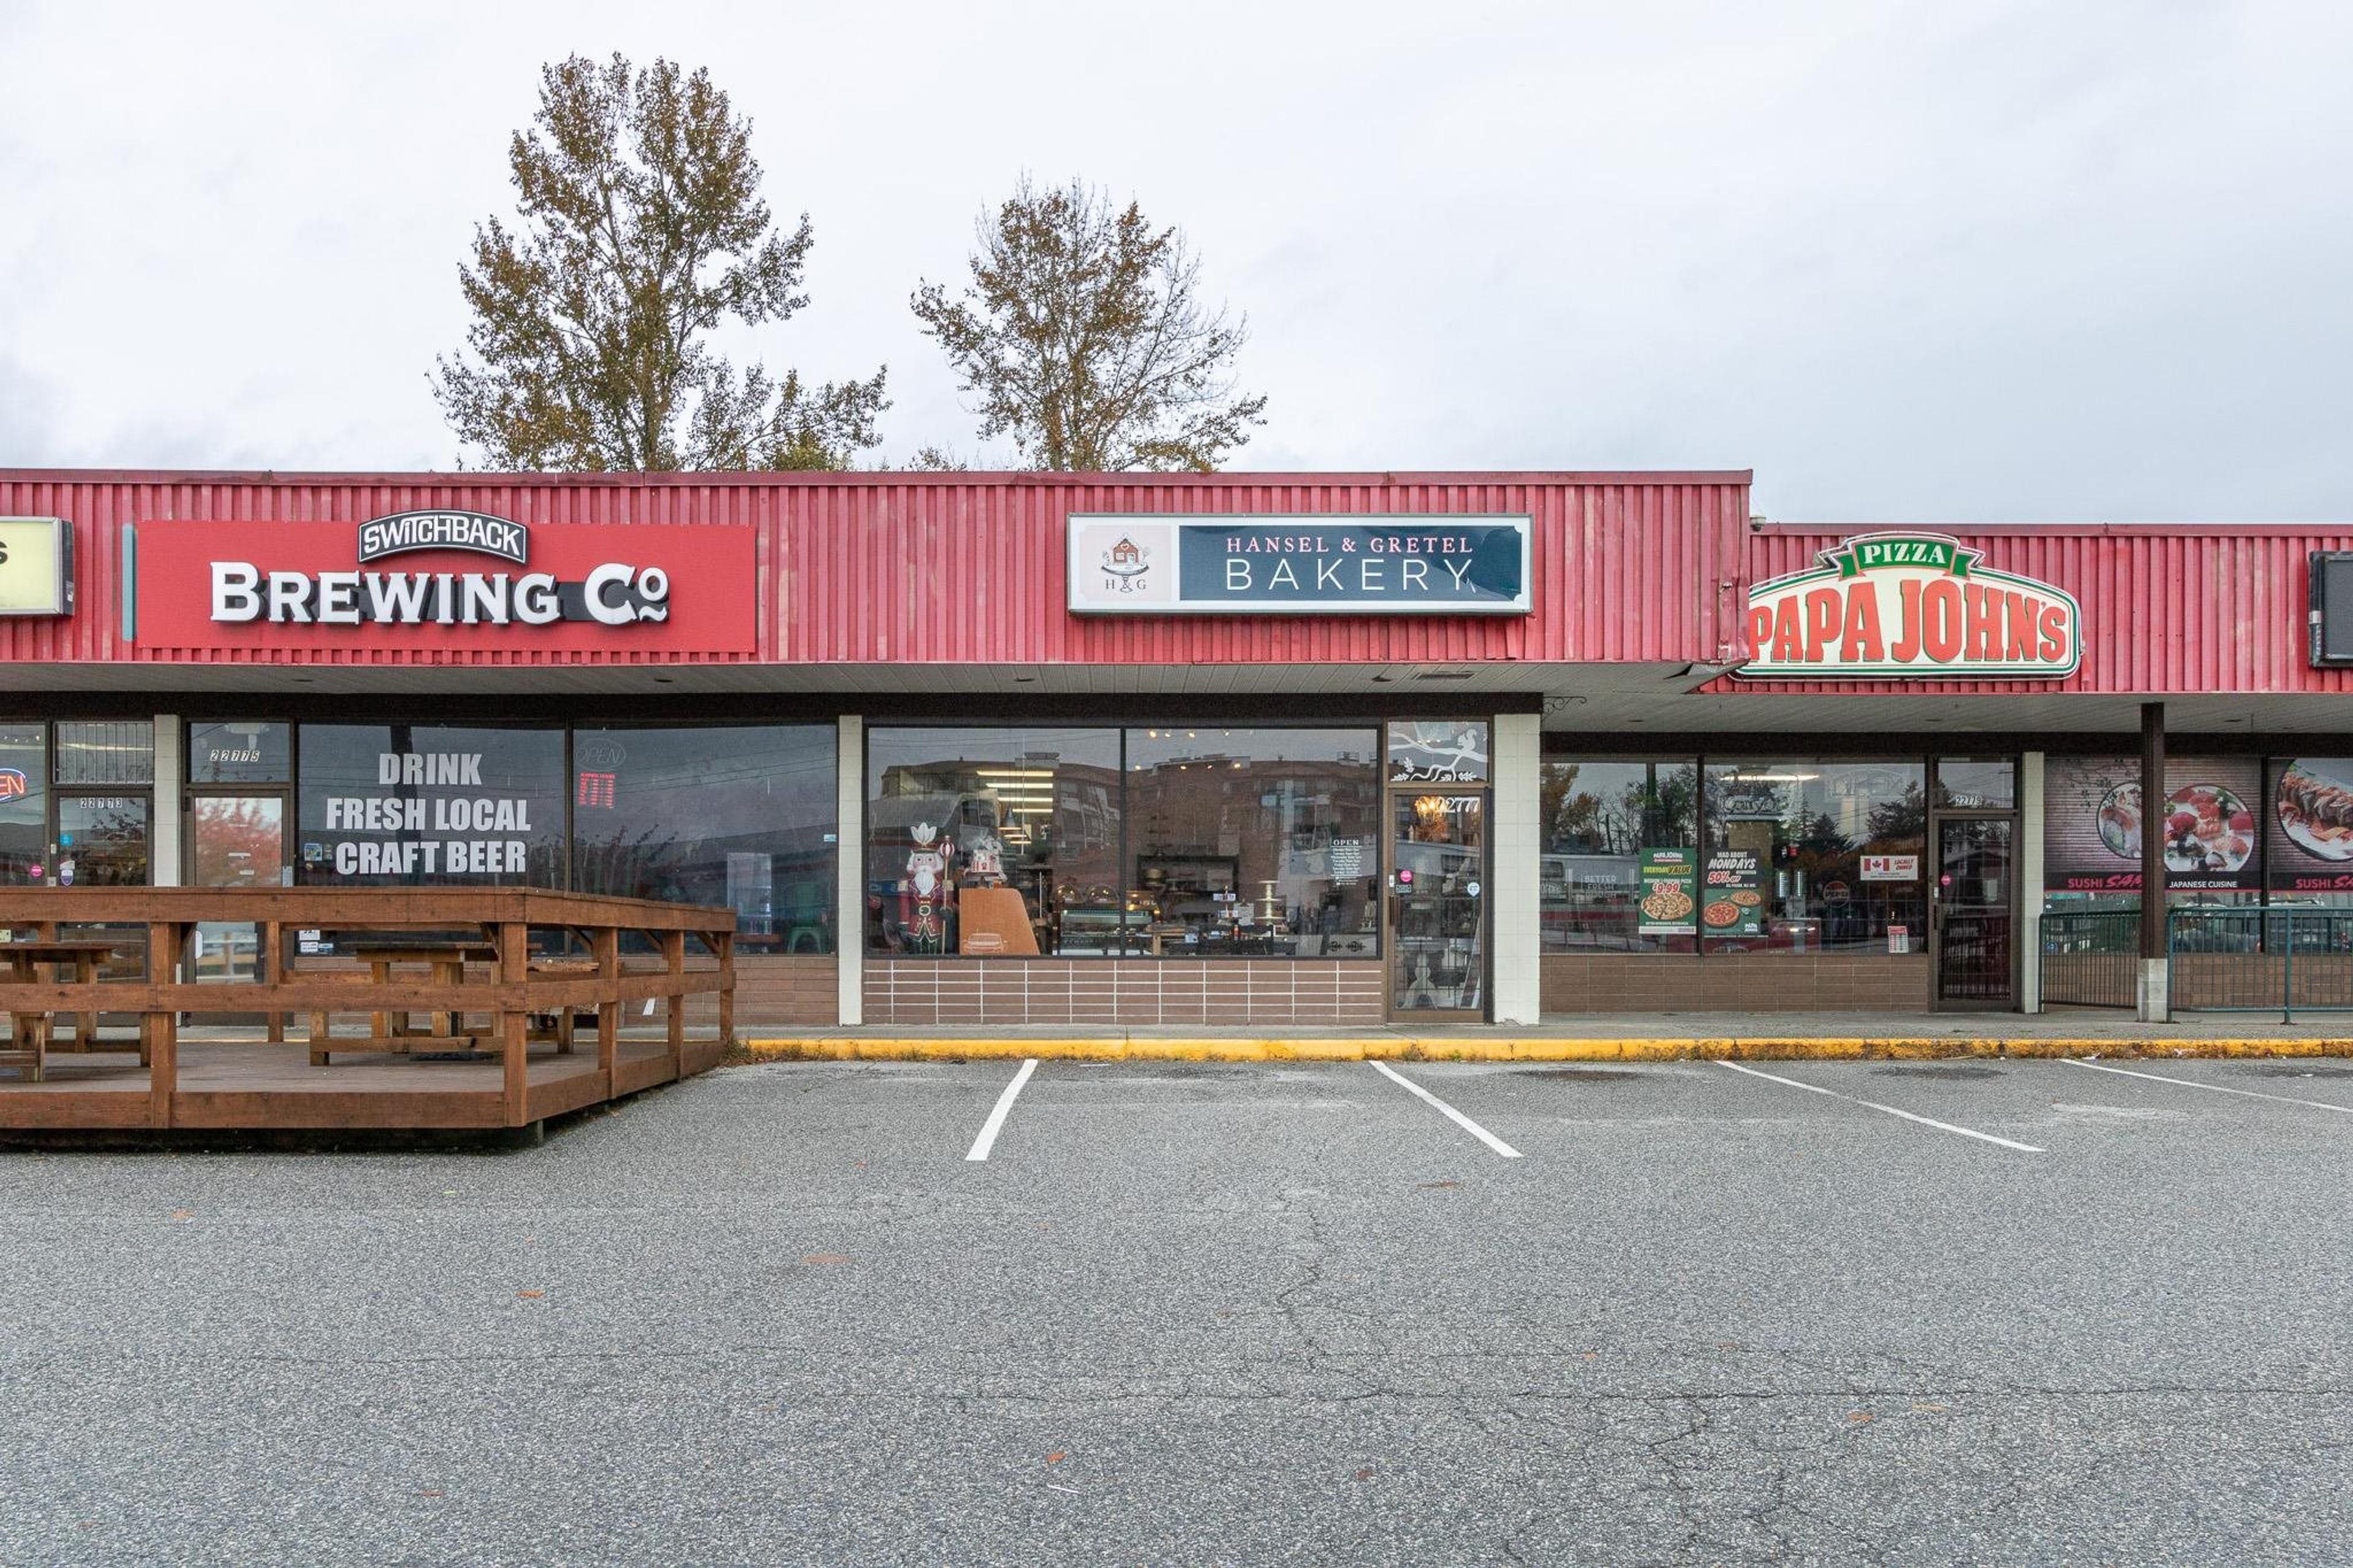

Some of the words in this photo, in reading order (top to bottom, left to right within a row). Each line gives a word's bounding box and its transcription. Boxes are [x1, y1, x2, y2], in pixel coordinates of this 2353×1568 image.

[1227, 537, 1328, 552] HANSEL
[1342, 538, 1356, 552] &
[1370, 537, 1472, 553] GRETEL
[1863, 543, 1947, 564] PIZZA
[1226, 558, 1472, 591] BAKERY
[1106, 579, 1115, 589] H
[1137, 579, 1146, 590] G
[210, 561, 560, 625] BREWING
[1749, 581, 1885, 662] PAPA
[1891, 578, 2067, 663] JOHN'S
[210, 749, 260, 762] 22775
[379, 754, 482, 785] DRINK
[80, 797, 123, 809] 22773
[326, 798, 426, 830] FRESH
[435, 799, 531, 831] LOCAL
[336, 842, 439, 874] CRAFT
[447, 841, 526, 873] BEER
[1708, 858, 1756, 869] MONDAYS
[1708, 871, 1730, 884] 50%
[2068, 878, 2103, 888] SUSHI
[2296, 879, 2331, 888] SUSHI
